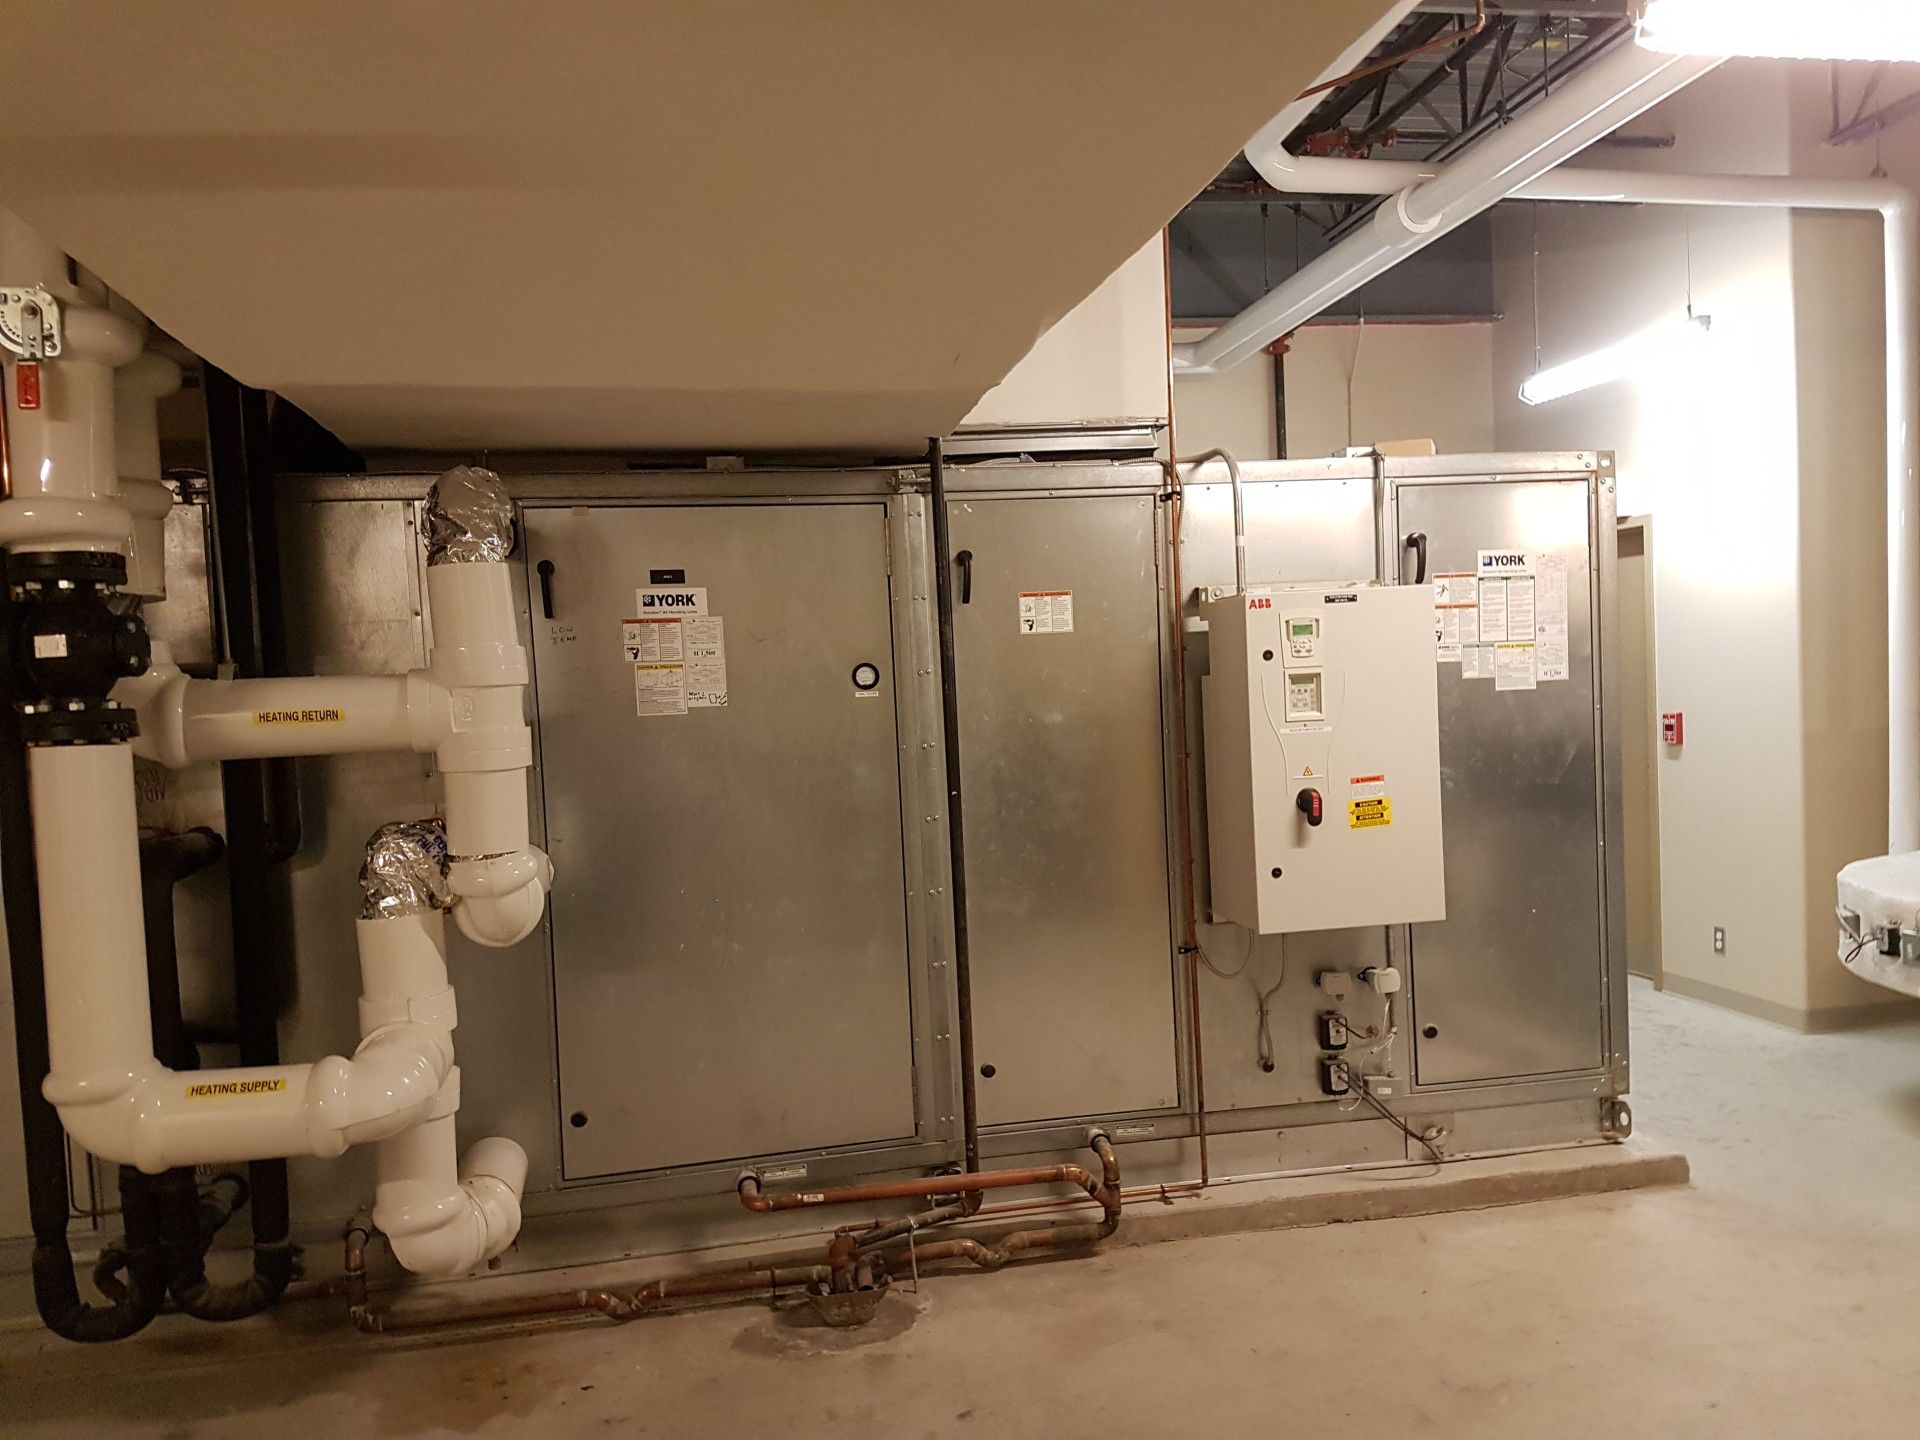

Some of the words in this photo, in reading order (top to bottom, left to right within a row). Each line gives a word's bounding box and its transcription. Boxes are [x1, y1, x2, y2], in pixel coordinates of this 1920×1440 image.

[1494, 555, 1526, 566] YORK
[656, 594, 696, 607] YORK
[1249, 599, 1271, 609] ABB
[258, 711, 299, 722] HEATING
[301, 709, 339, 721] RETURN
[190, 1082, 237, 1096] HEATING
[239, 1079, 280, 1093] SUPPLY
